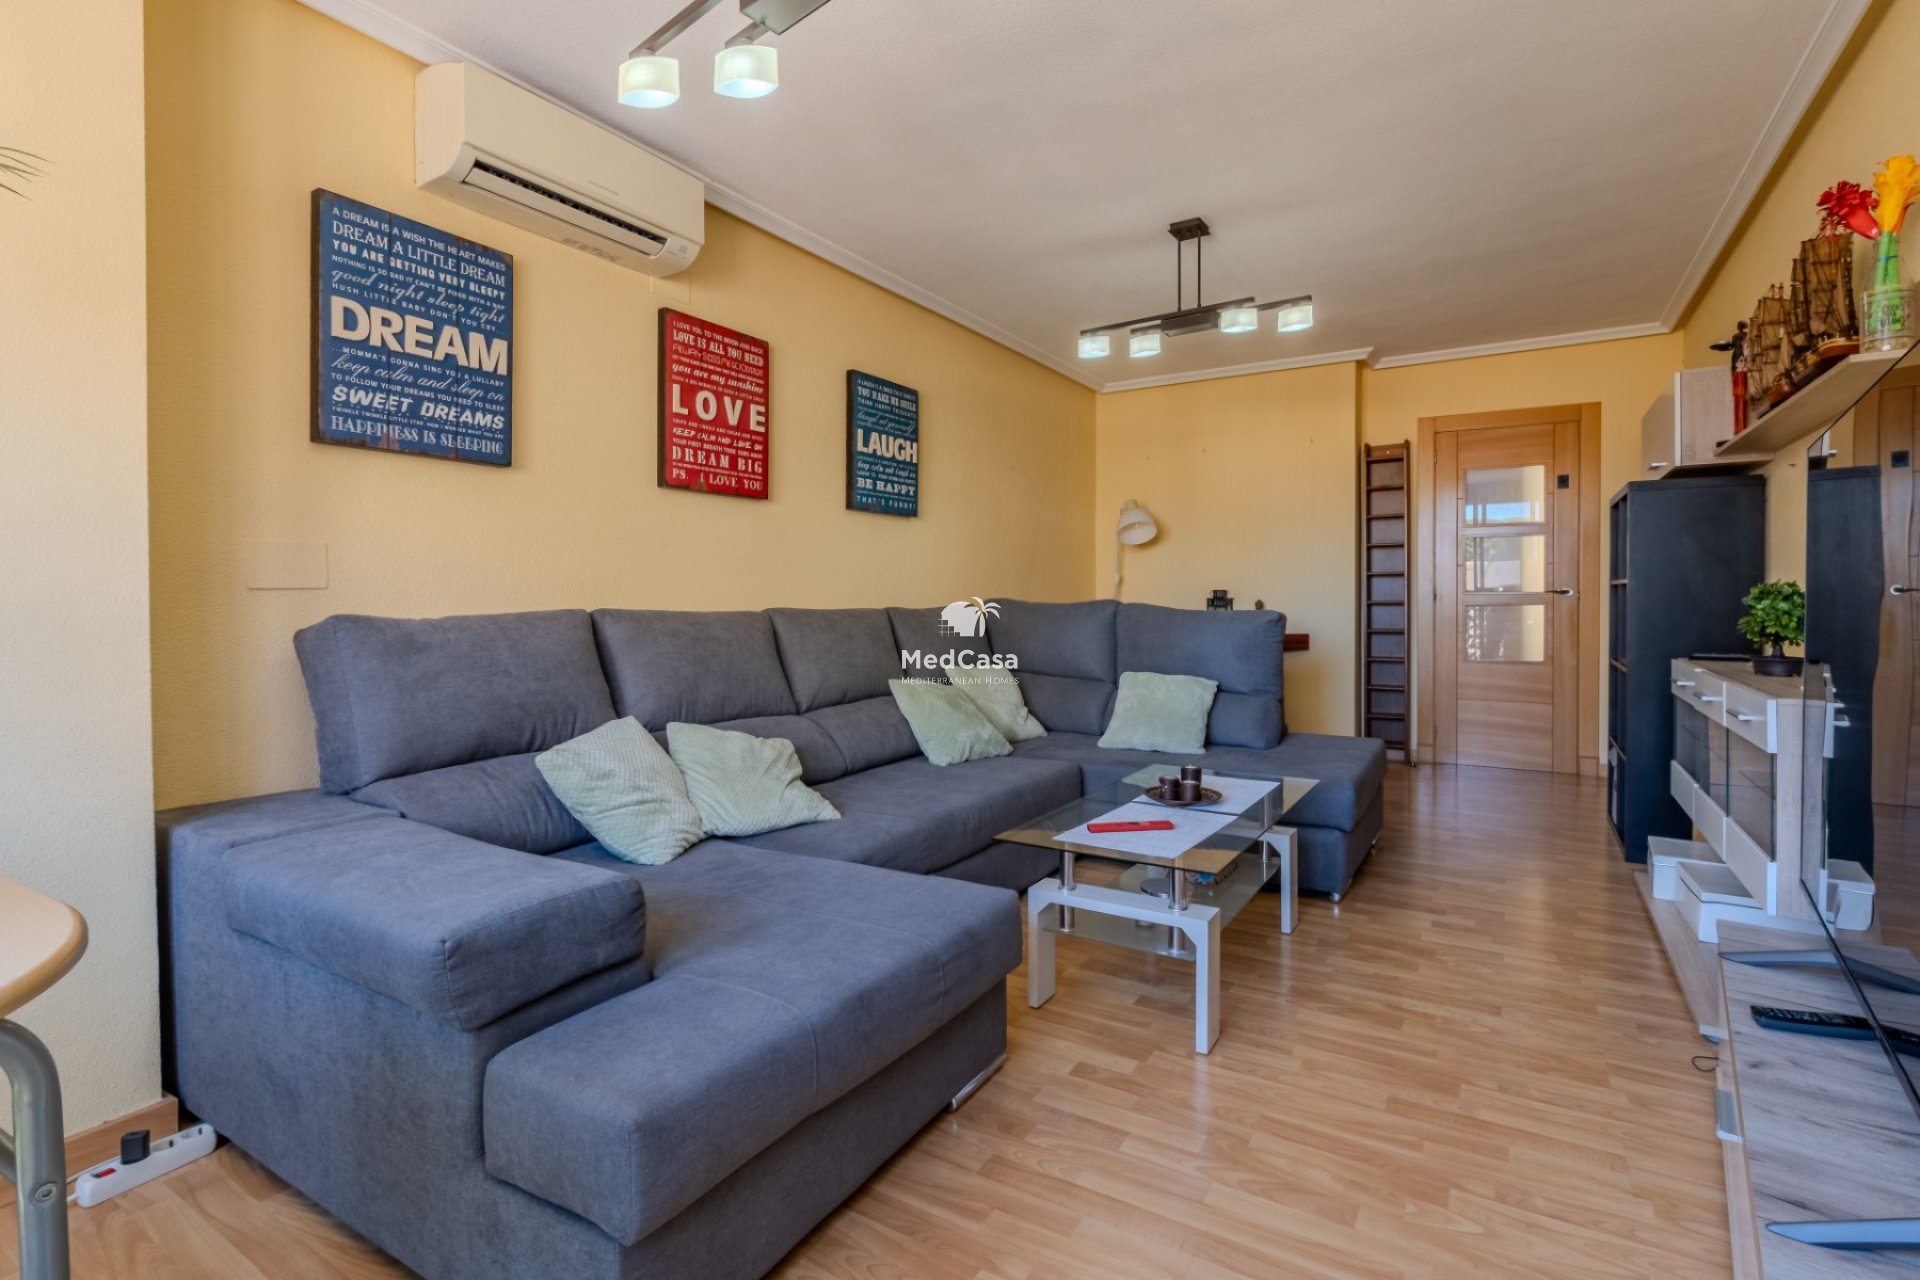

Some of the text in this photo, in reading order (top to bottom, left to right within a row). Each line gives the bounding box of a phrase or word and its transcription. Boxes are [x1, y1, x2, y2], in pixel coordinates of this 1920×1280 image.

[332, 207, 506, 271] A DREAM IS A WISH THE HEART MAKES
[333, 220, 505, 287] DREAM A LITTLE DREAM
[332, 239, 505, 300] YOU ARE GETTING VERY SLEEPY
[332, 255, 366, 270] NOTHING
[377, 268, 387, 276] SO
[390, 272, 404, 281] BAD
[415, 279, 435, 289] CAN'T
[468, 295, 485, 304] WITH
[331, 270, 379, 286] good
[378, 282, 424, 300] night
[428, 290, 465, 314] sleep
[332, 282, 359, 294] HUSH
[364, 290, 397, 305] LITTLE
[402, 301, 425, 312] BABY
[430, 309, 456, 320] DON'T
[461, 318, 477, 327] YOU
[331, 296, 508, 376] DREAM
[673, 330, 764, 367] LOVE IS ALL YOU NEED
[677, 321, 690, 331] LOVE
[713, 332, 722, 341] THE
[331, 354, 504, 400] keep calm and sleep on
[331, 372, 342, 381] TO
[345, 376, 378, 387] FOLLOW
[381, 383, 401, 391] YOUR
[404, 387, 434, 399] DREAMS
[437, 394, 452, 402] YOU
[474, 400, 483, 408] TO
[486, 403, 505, 412] SLEEP
[390, 357, 419, 369] GONNA
[423, 364, 442, 374] SING
[472, 375, 504, 388] LULLABY
[672, 363, 764, 394] you are my sunshine
[332, 386, 504, 430] SWEET DREAMS
[332, 406, 359, 415] TWINKLE
[362, 411, 387, 420] TWINKLE
[673, 384, 766, 432] LOVE
[331, 415, 504, 455] HAPPINESS IS SLEEPING
[673, 427, 695, 437] KEEP
[697, 432, 716, 441] CALM
[718, 436, 731, 444] AND
[734, 439, 752, 448] LOVE
[857, 428, 918, 463] LAUGH
[672, 446, 729, 468] DREAM
[738, 458, 762, 474] BIG
[709, 474, 738, 487] LOVE
[744, 479, 763, 490] YOU
[857, 478, 873, 489] BE
[876, 481, 915, 496] HAPPY
